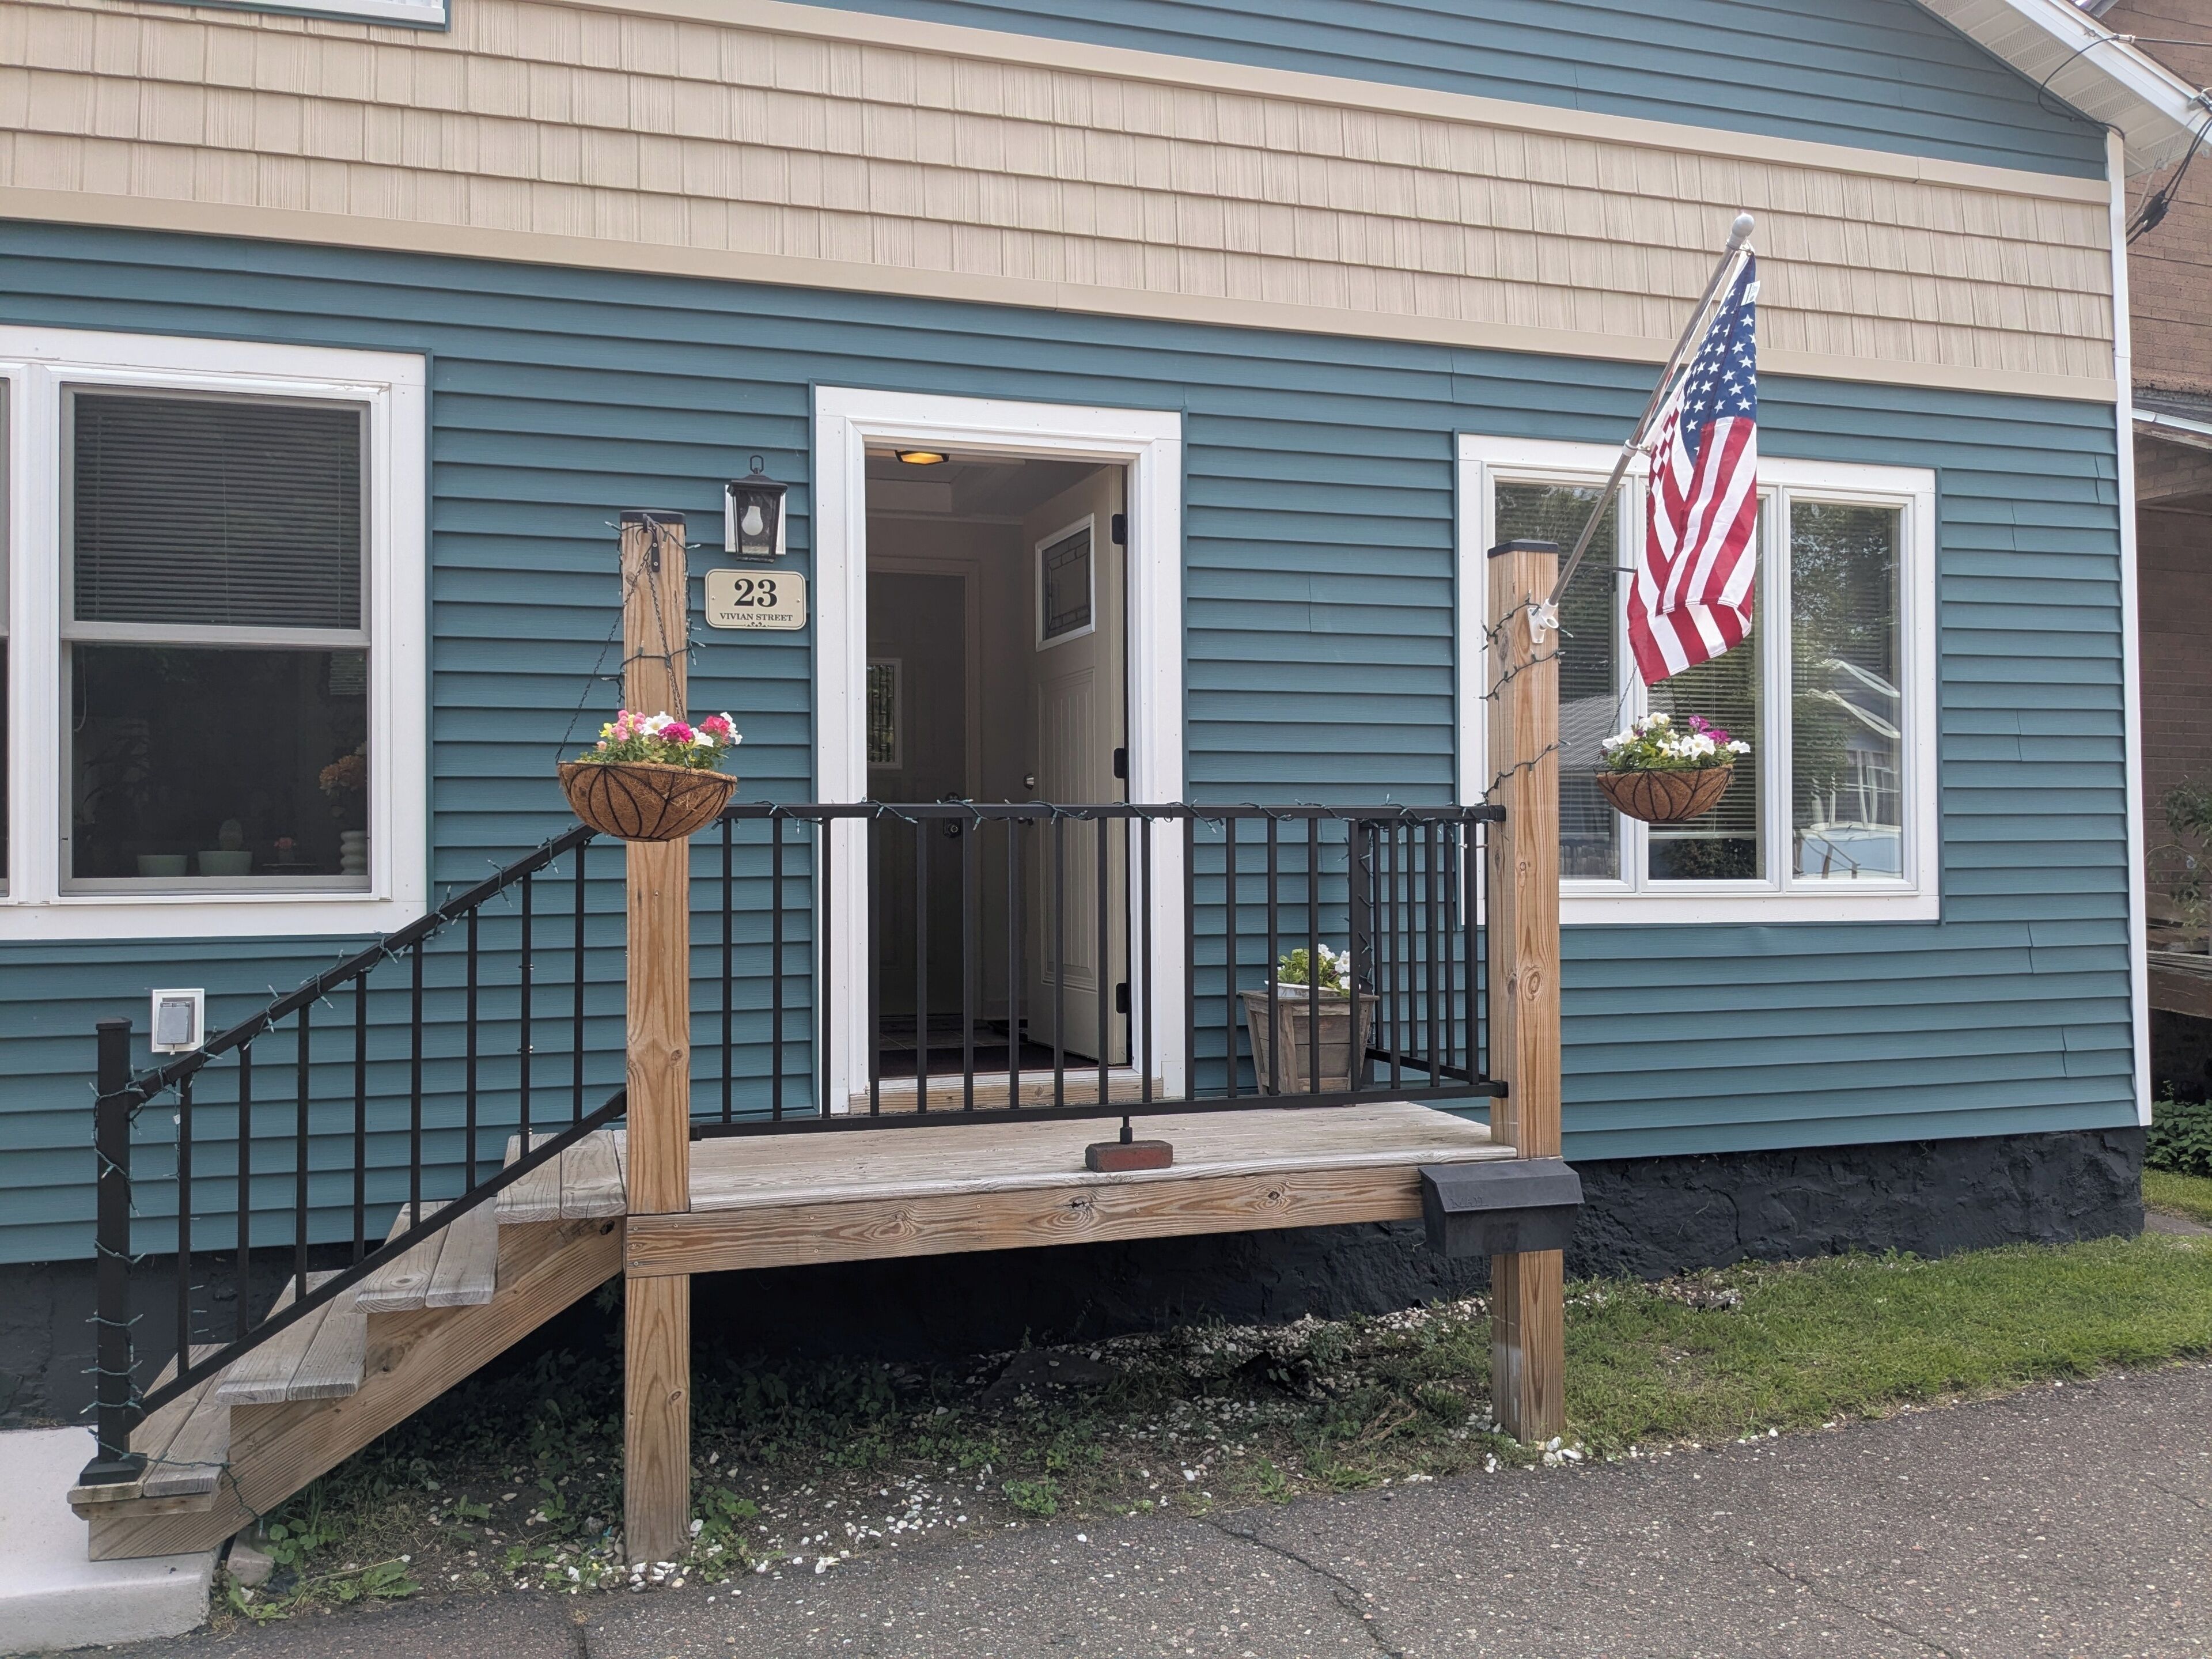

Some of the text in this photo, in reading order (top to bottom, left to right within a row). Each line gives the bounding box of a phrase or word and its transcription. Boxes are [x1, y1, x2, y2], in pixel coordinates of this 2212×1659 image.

[734, 578, 778, 608] 23
[719, 612, 793, 622] VIVIAN STREET
[1450, 1196, 1488, 1208] MAIL
